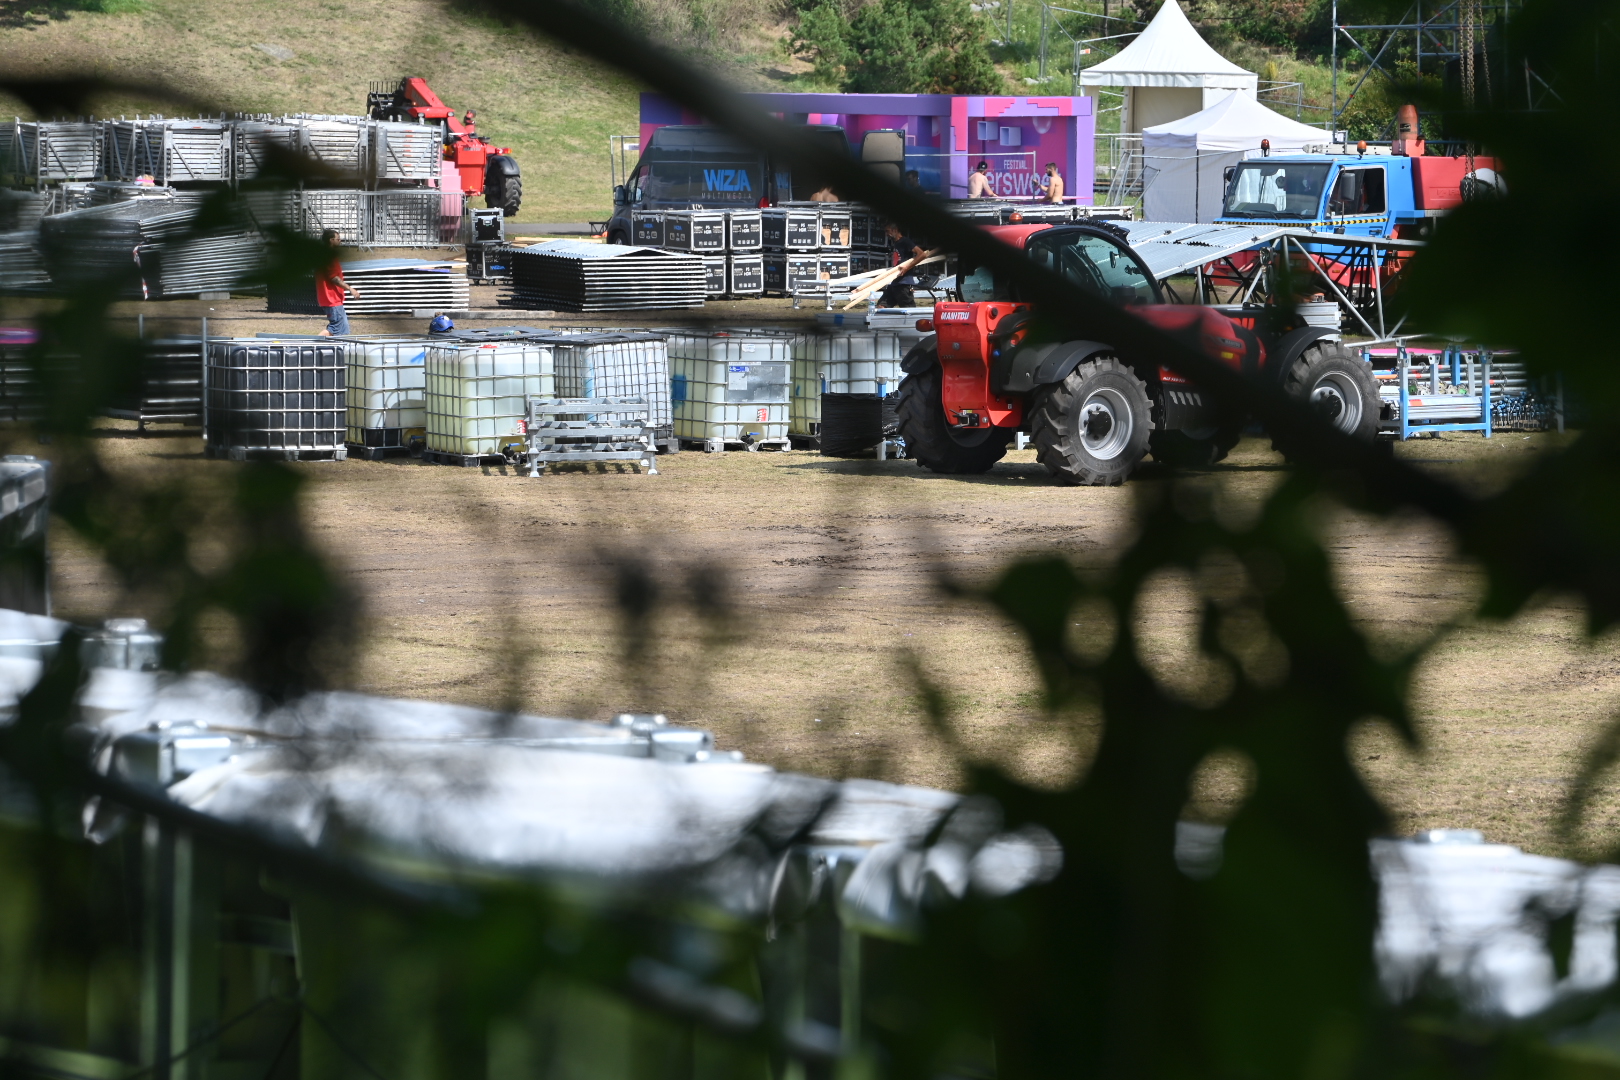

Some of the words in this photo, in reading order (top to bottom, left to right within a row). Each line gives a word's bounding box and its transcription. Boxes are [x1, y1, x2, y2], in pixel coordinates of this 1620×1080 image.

[1003, 159, 1027, 170] FESTIVAL
[703, 169, 752, 191] WIZJA
[701, 192, 752, 200] MULTIMEDIA
[940, 311, 970, 320] MANITOU
